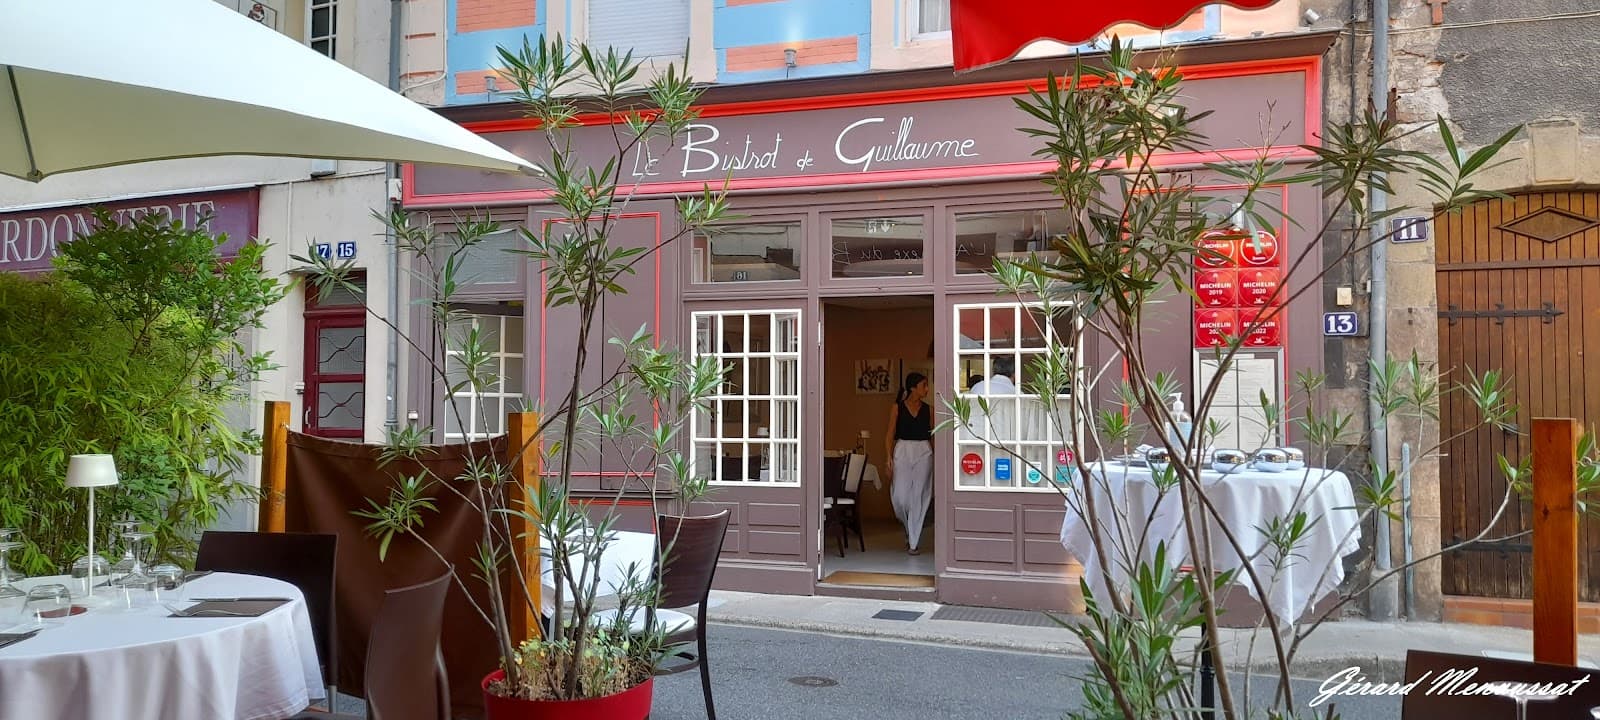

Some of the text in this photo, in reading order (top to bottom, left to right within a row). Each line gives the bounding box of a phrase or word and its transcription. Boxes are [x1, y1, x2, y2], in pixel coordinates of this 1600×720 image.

[632, 116, 980, 177] Le Bistrot de Guillaume
[1399, 219, 1419, 240] 11
[339, 243, 354, 257] 15
[1327, 315, 1354, 333] 13
